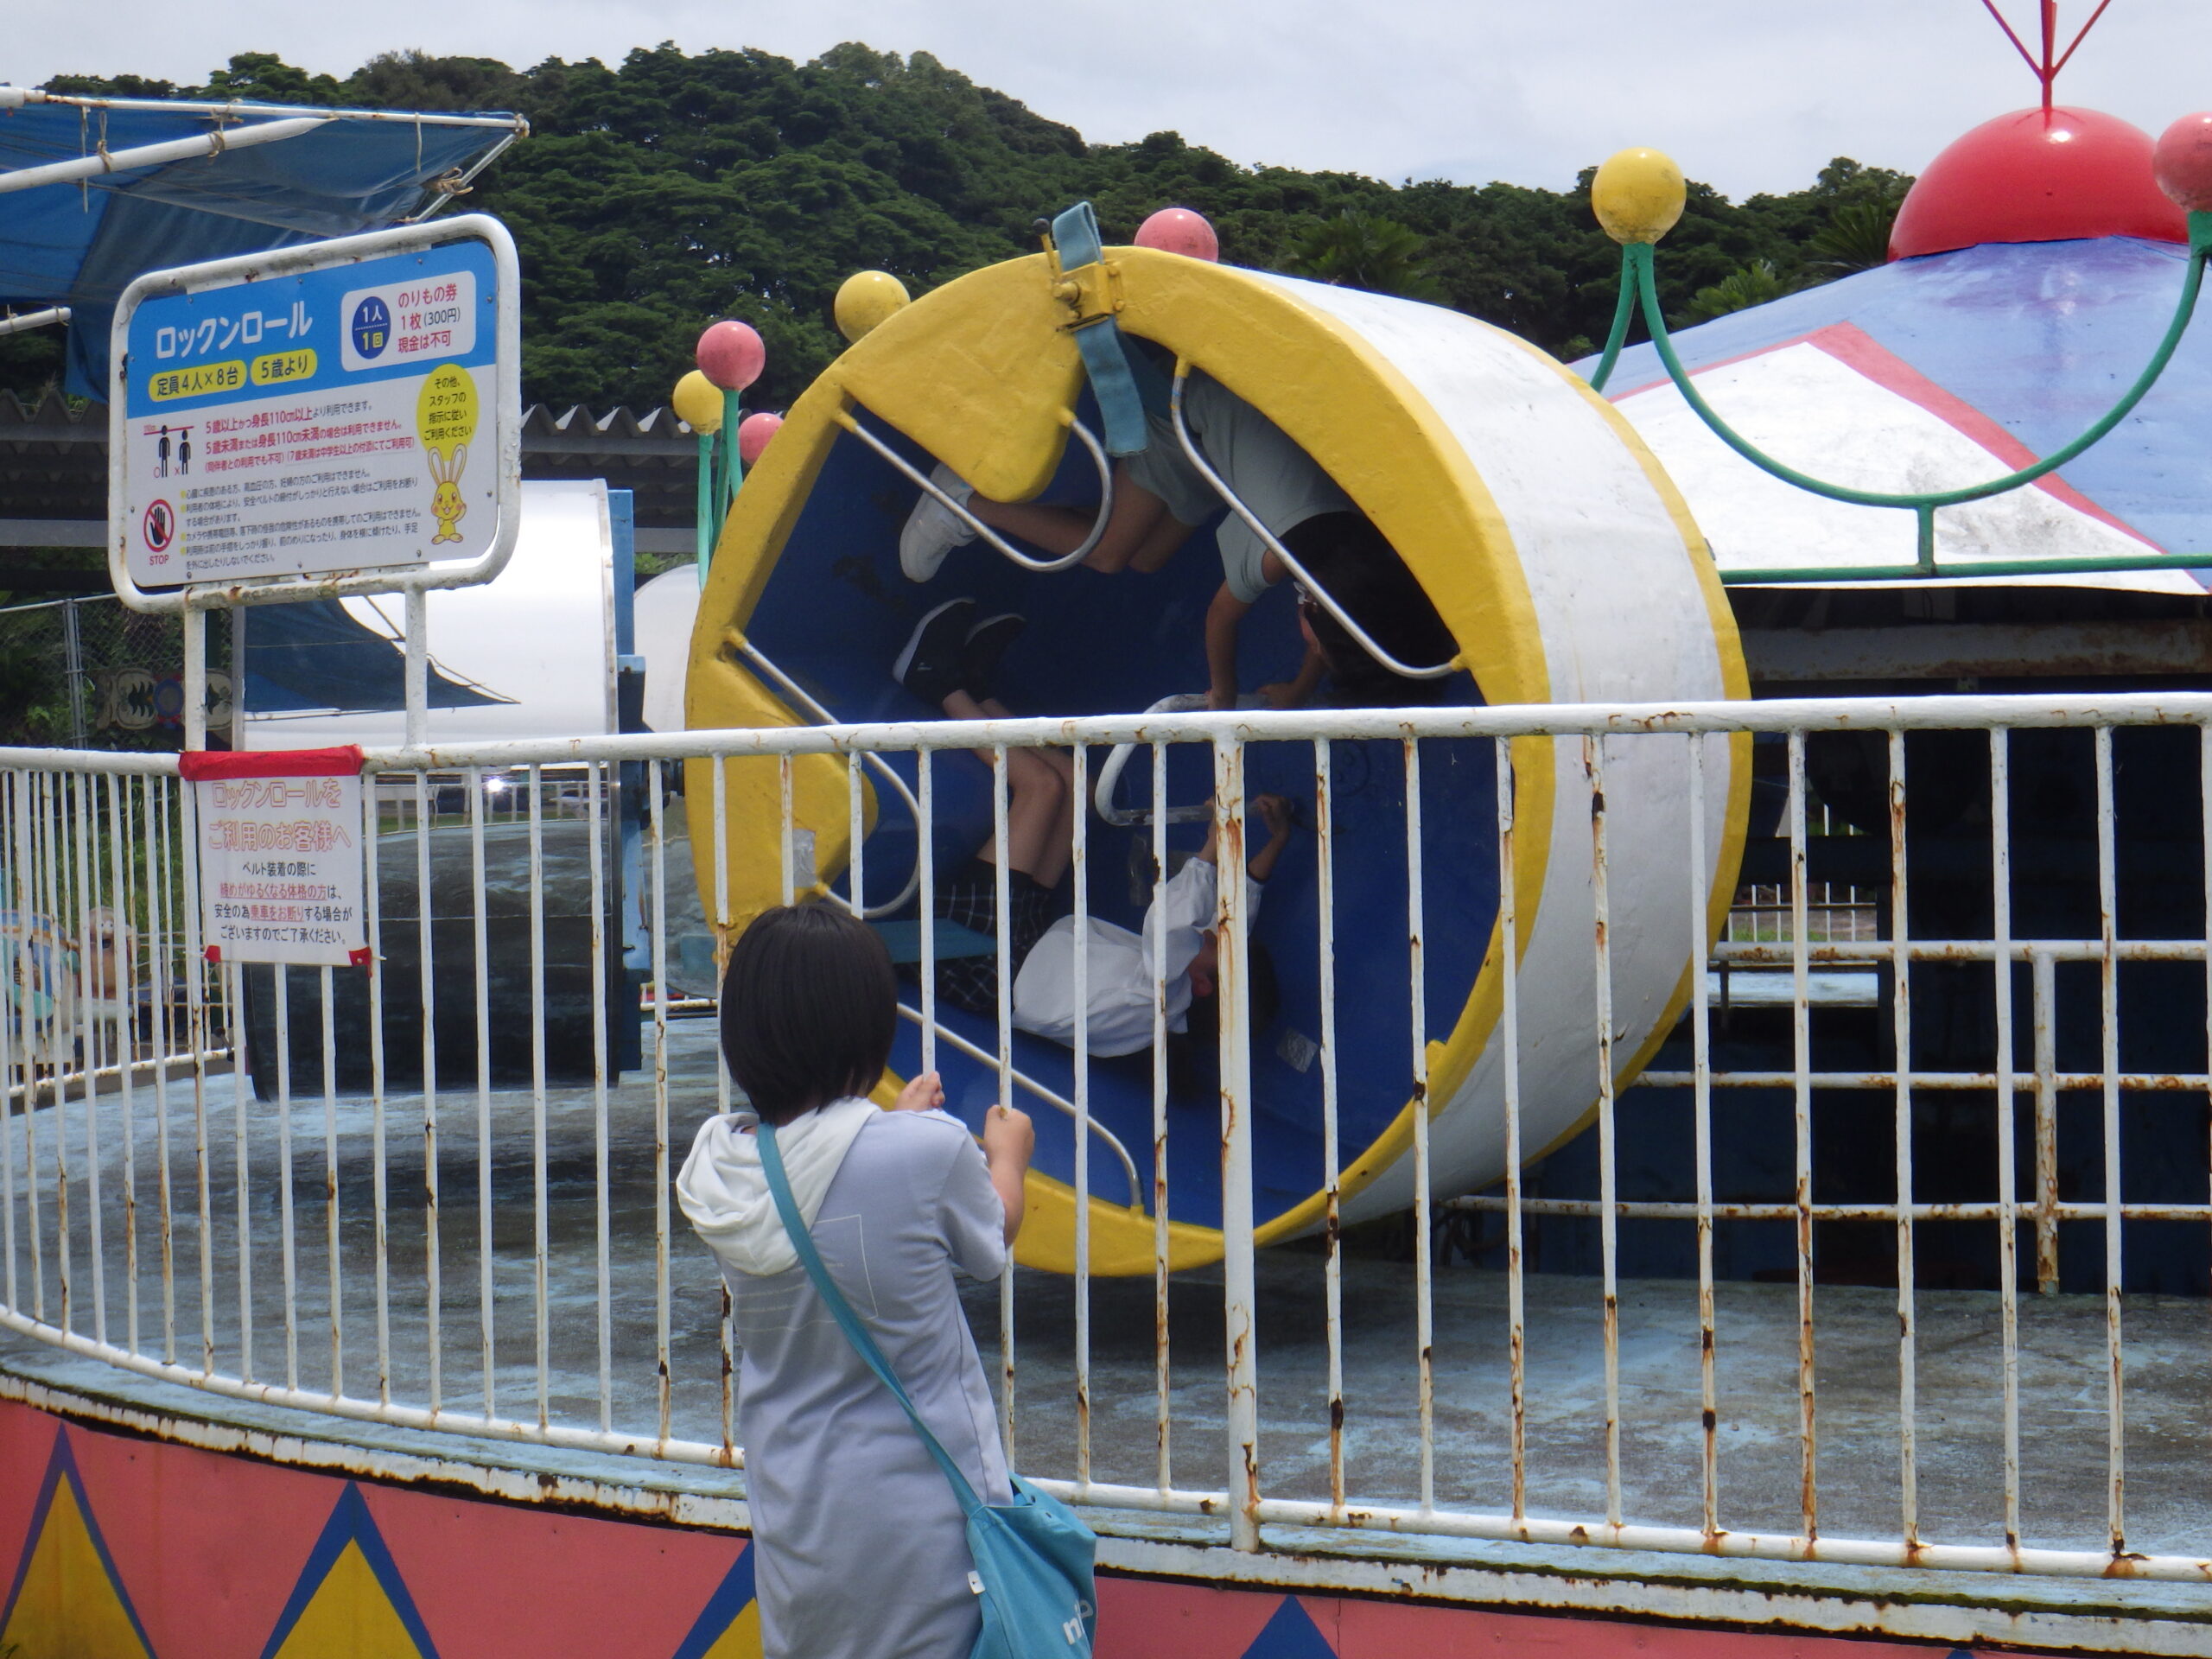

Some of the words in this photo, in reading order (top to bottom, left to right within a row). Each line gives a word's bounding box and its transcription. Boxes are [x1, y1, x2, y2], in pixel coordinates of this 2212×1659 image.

[397, 283, 457, 308] のりもの券
[362, 305, 383, 323] 1人
[156, 300, 313, 359] ロックンロール
[362, 332, 383, 351] 1回
[397, 330, 452, 353] 現金は不可
[261, 354, 308, 379] 5歳より
[429, 391, 466, 408] スタッフの
[429, 409, 467, 424] 指示に従い
[423, 425, 472, 441] ご利用ください
[149, 554, 169, 566] STOP
[212, 778, 341, 810] ロックンロールを
[208, 819, 352, 853] ご利用のお客様へ
[241, 861, 317, 877] ベルト装着の際に
[214, 904, 353, 921] 安全の為乗車をお断りする場合が
[220, 925, 346, 944] ございますのでご了承ください。
